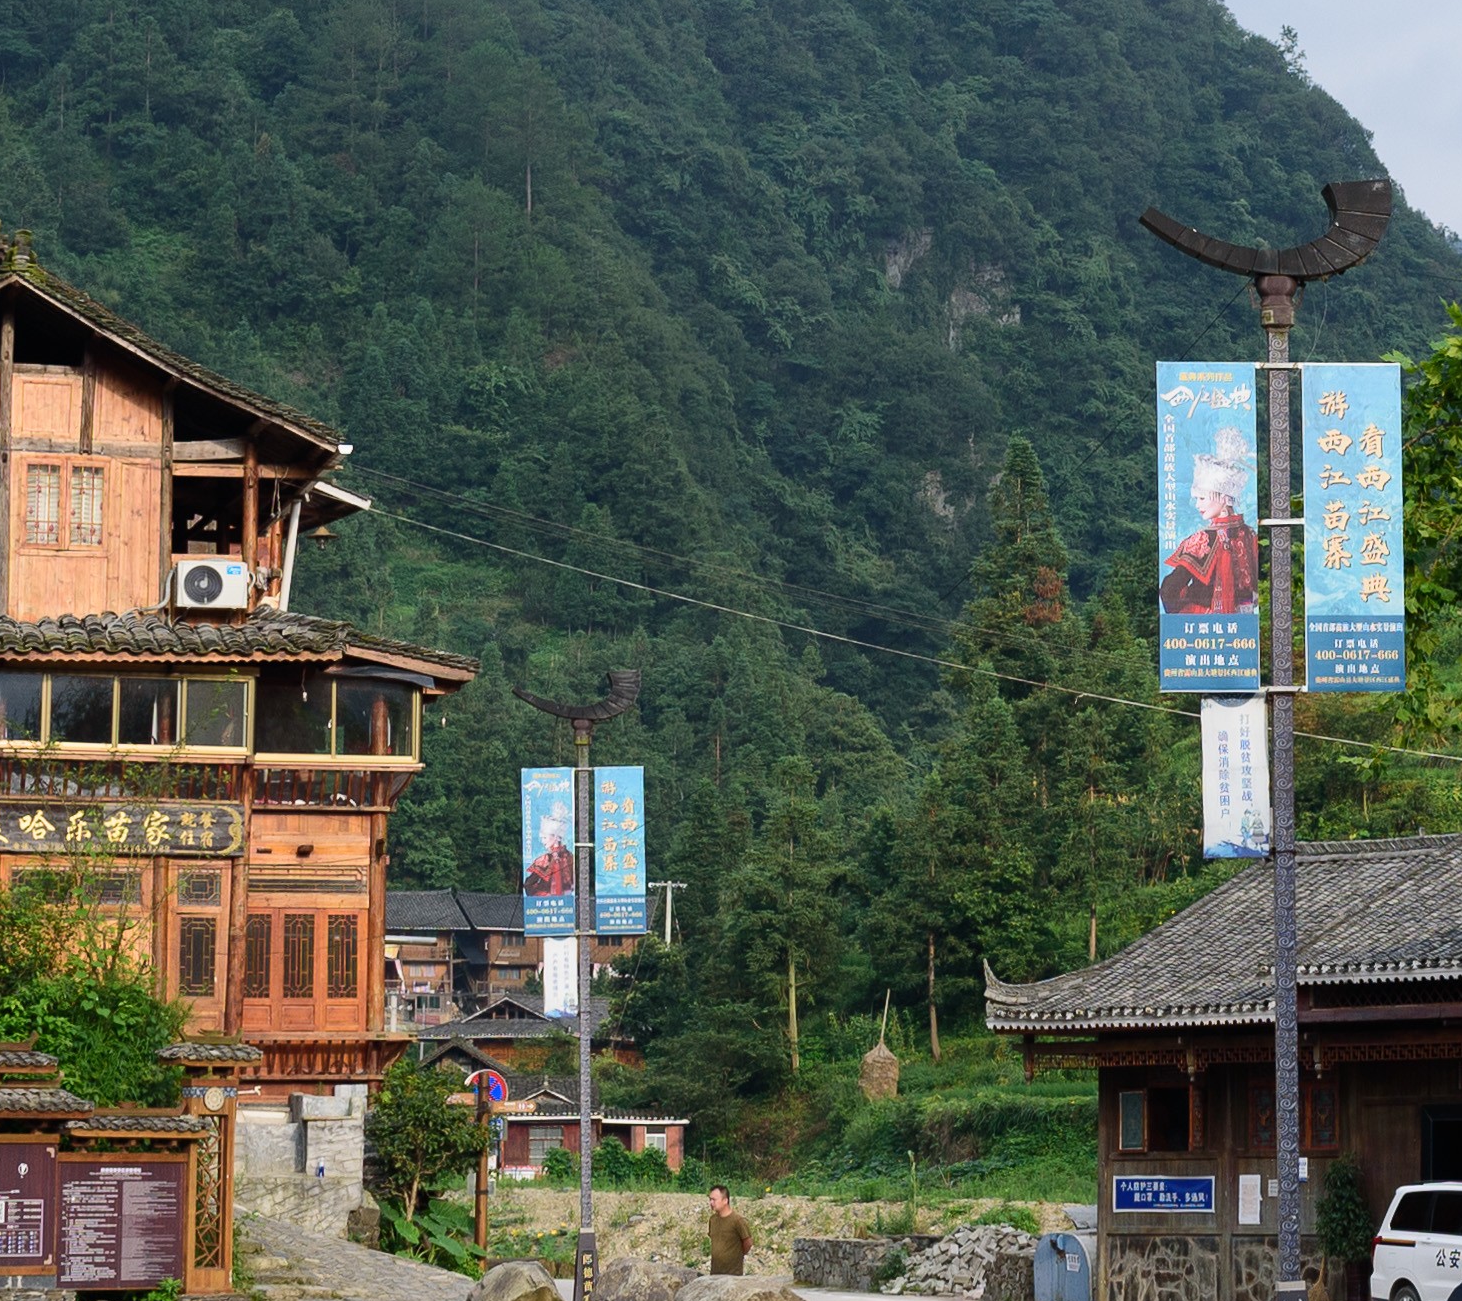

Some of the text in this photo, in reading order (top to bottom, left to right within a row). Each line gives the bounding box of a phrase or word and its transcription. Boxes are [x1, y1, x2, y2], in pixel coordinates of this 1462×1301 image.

[1317, 389, 1353, 570] 游西江苗寨
[1355, 422, 1391, 603] 看西江盛典
[1184, 622, 1238, 634] 订票电话
[1163, 638, 1256, 649] 400-0617-666
[1334, 639, 1379, 649] 订票电话
[1185, 654, 1240, 666] 演出地点
[1315, 650, 1399, 660] 400-0617-666
[1335, 663, 1380, 674] 演出地点
[1436, 1249, 1461, 1269] 公安
